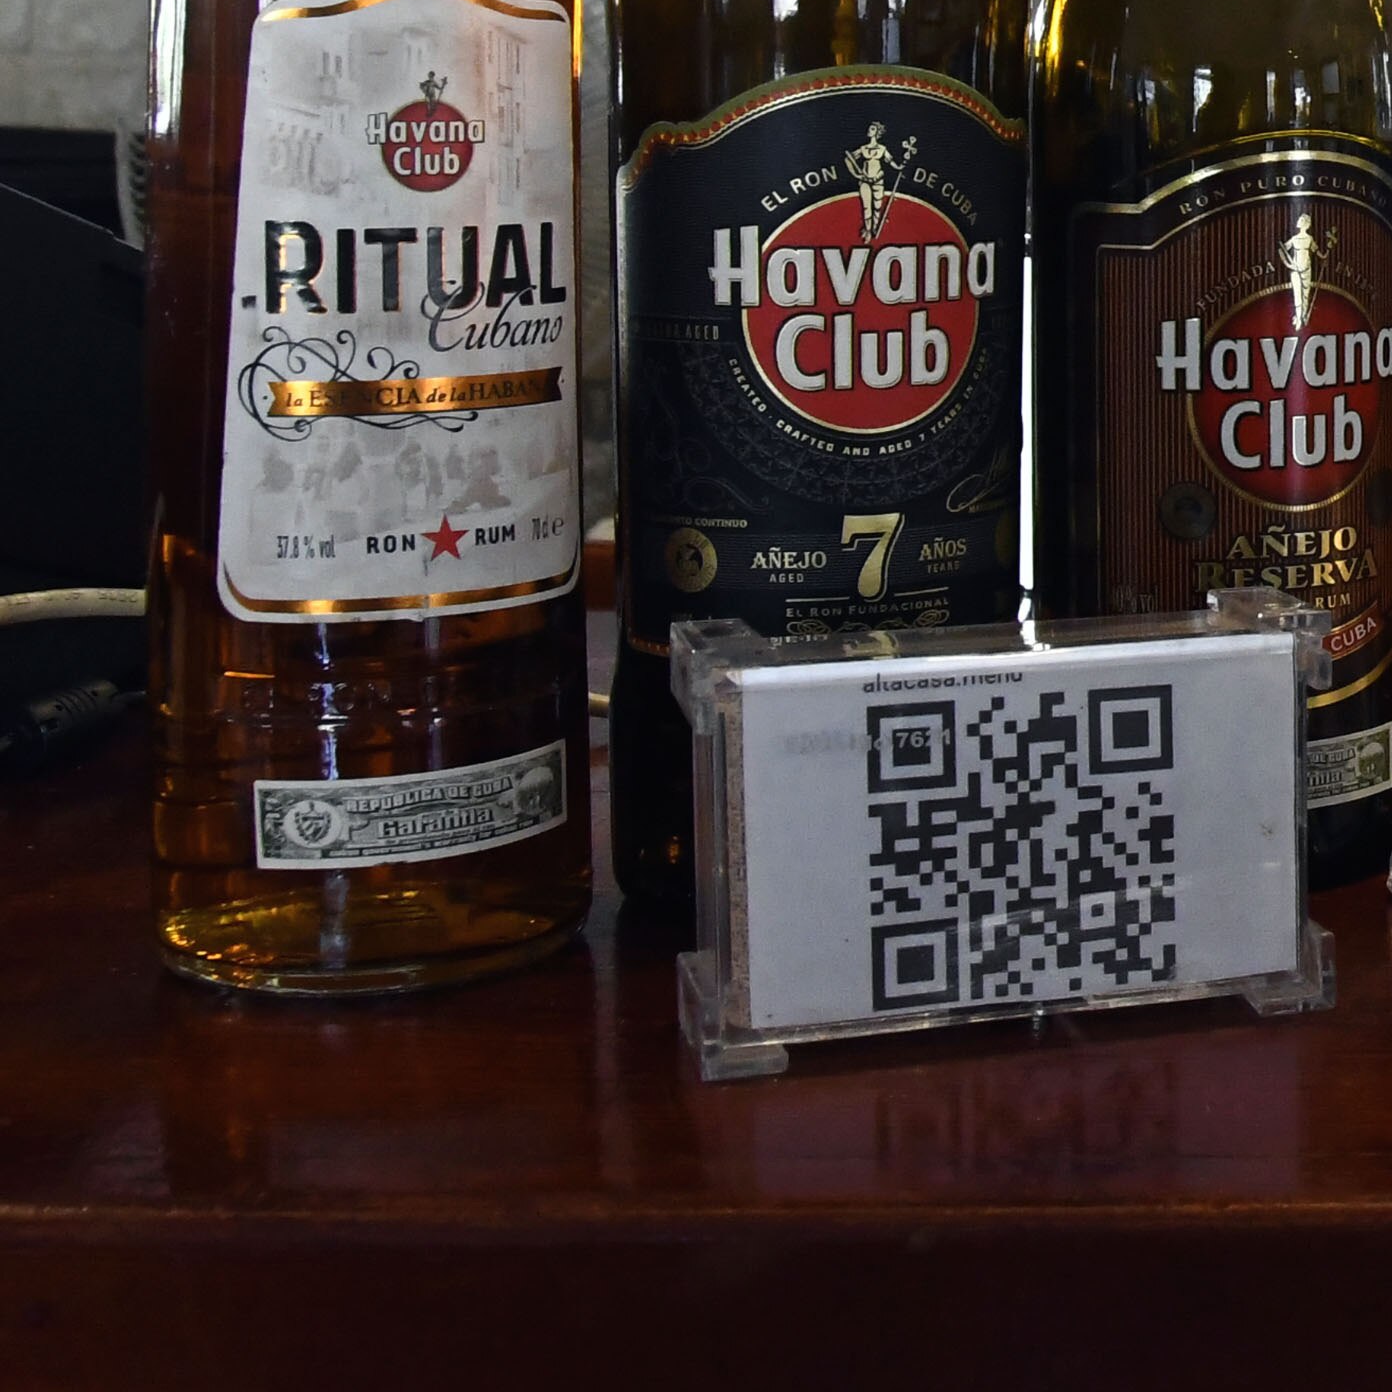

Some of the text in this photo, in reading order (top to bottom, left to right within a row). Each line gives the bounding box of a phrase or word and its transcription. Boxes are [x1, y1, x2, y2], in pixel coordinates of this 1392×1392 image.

[366, 112, 486, 146] Havana
[392, 147, 461, 177] Club
[760, 165, 978, 227] EL RON DE CUBA
[1178, 187, 1227, 216] RON
[1240, 174, 1306, 194] PURO
[263, 219, 568, 315] RITUAL
[707, 224, 998, 308] Havana
[420, 279, 564, 353] Cubano
[775, 309, 951, 392] Club
[727, 357, 768, 415] CREATED
[775, 418, 835, 453] CRAFTED
[841, 444, 871, 457] AND
[878, 438, 914, 456] AGED
[1220, 394, 1364, 470] Club
[366, 534, 416, 555] RON
[474, 523, 517, 546] RUM
[749, 511, 968, 602] AÑEJO 7 AÑOS
[1227, 524, 1358, 562] AÑEJO
[769, 572, 805, 584] AGED
[1193, 547, 1378, 594] RESERVA
[785, 596, 950, 618] EL RON FUNDACIONAL
[1315, 592, 1352, 609] RUM
[1329, 617, 1377, 652] CUBA
